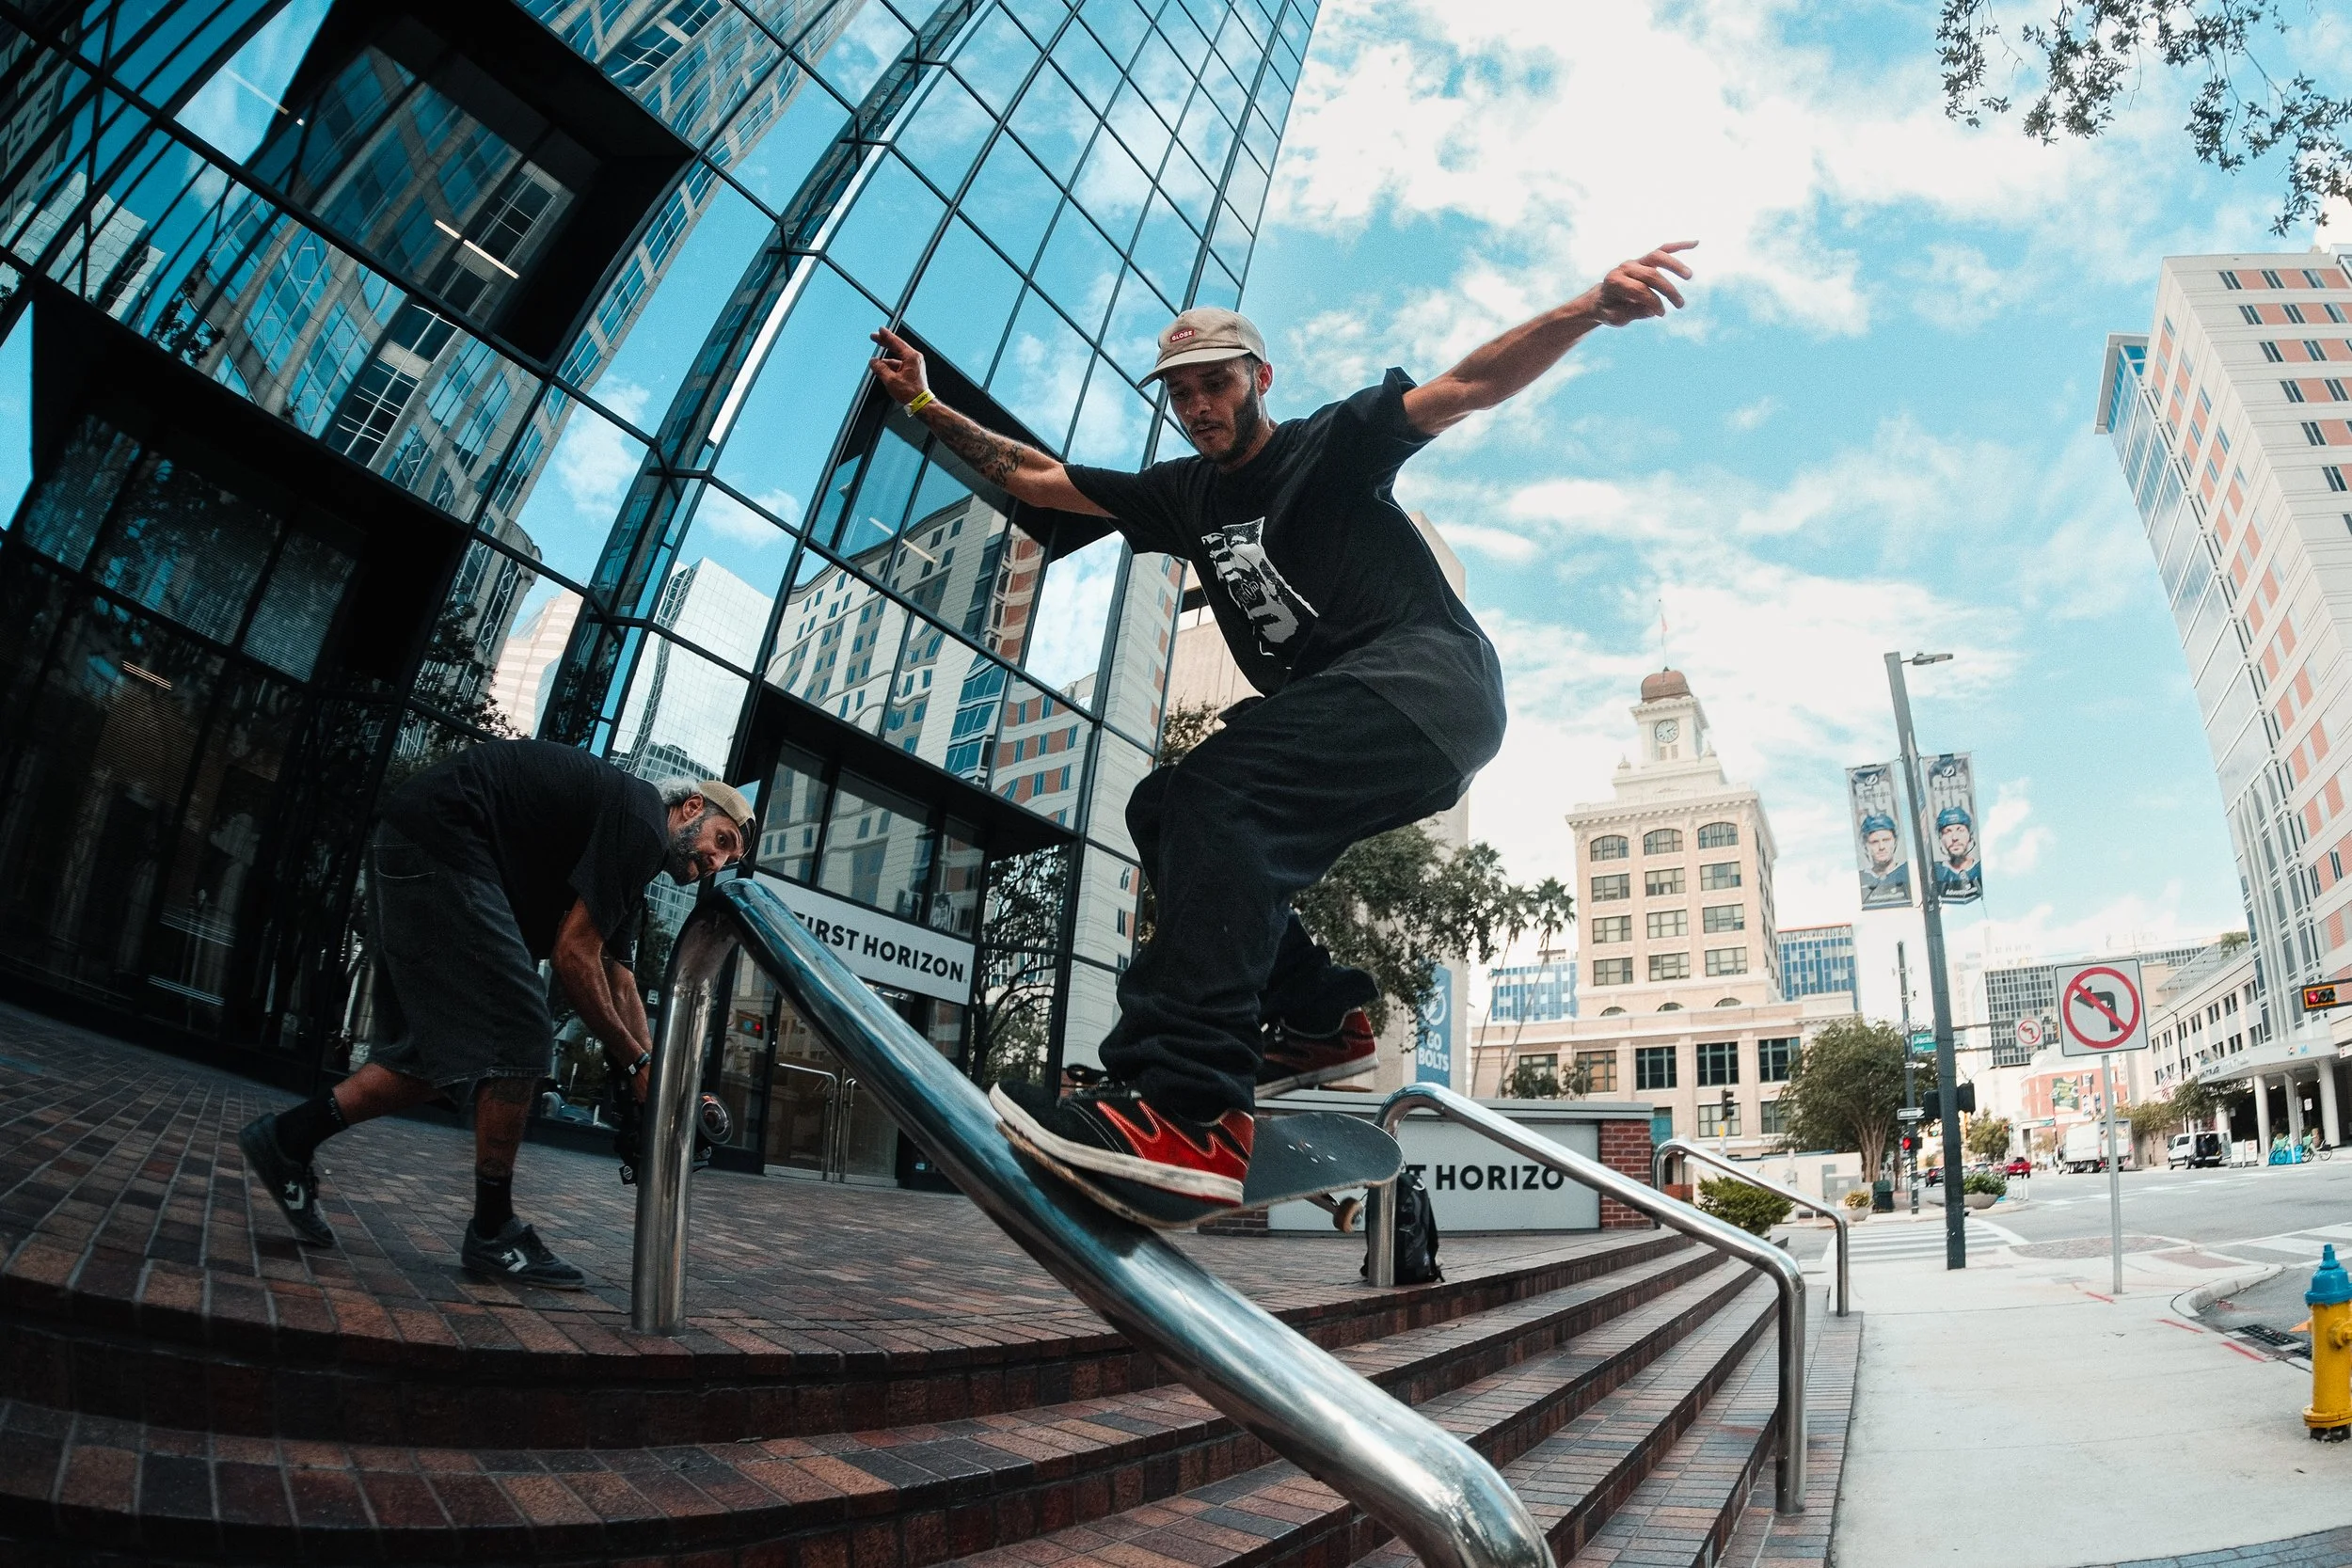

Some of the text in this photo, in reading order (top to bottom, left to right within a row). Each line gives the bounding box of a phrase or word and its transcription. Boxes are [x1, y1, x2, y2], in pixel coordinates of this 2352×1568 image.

[1171, 330, 1193, 341] GLOBE
[793, 911, 964, 984] IRST HORIZON
[1426, 1031, 1442, 1051] GO
[1418, 1047, 1450, 1072] BOLTS
[1436, 1164, 1565, 1191] HORIZO
